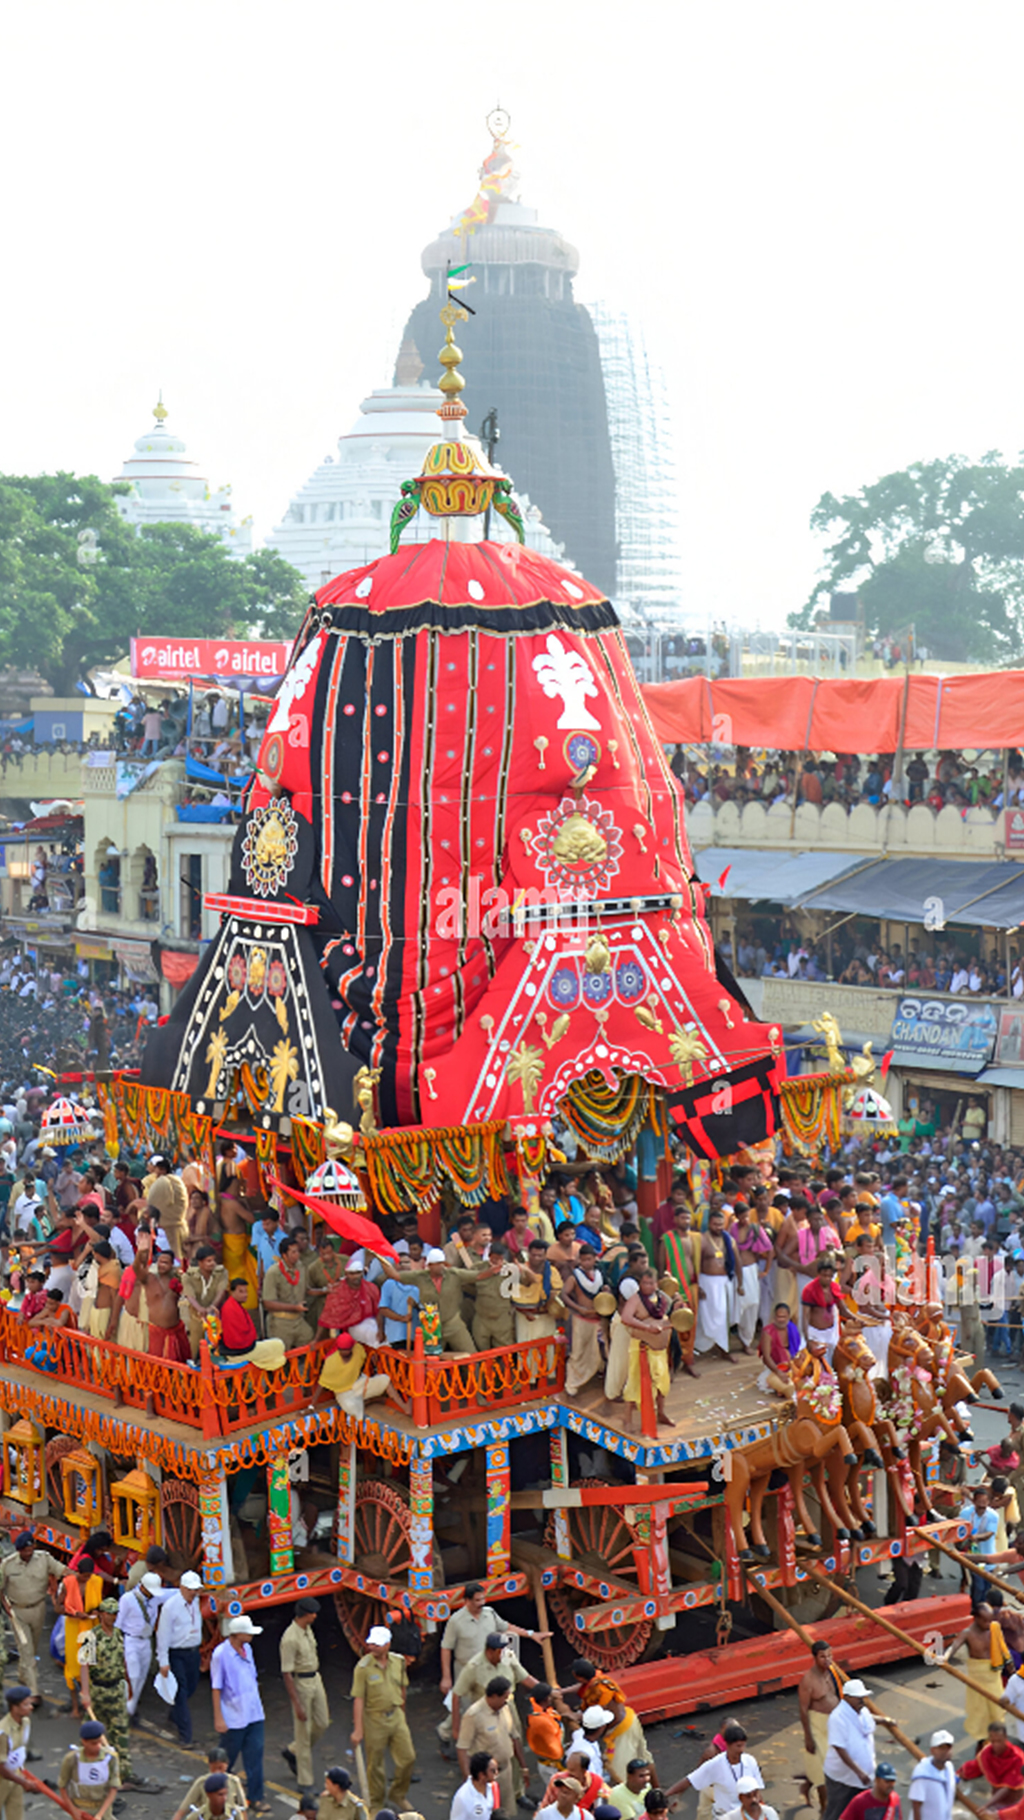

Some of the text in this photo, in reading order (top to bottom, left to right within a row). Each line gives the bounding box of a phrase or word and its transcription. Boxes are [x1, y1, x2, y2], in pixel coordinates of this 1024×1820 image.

[158, 644, 278, 674] airtel airtel
[892, 1021, 961, 1047] CHANDAN
